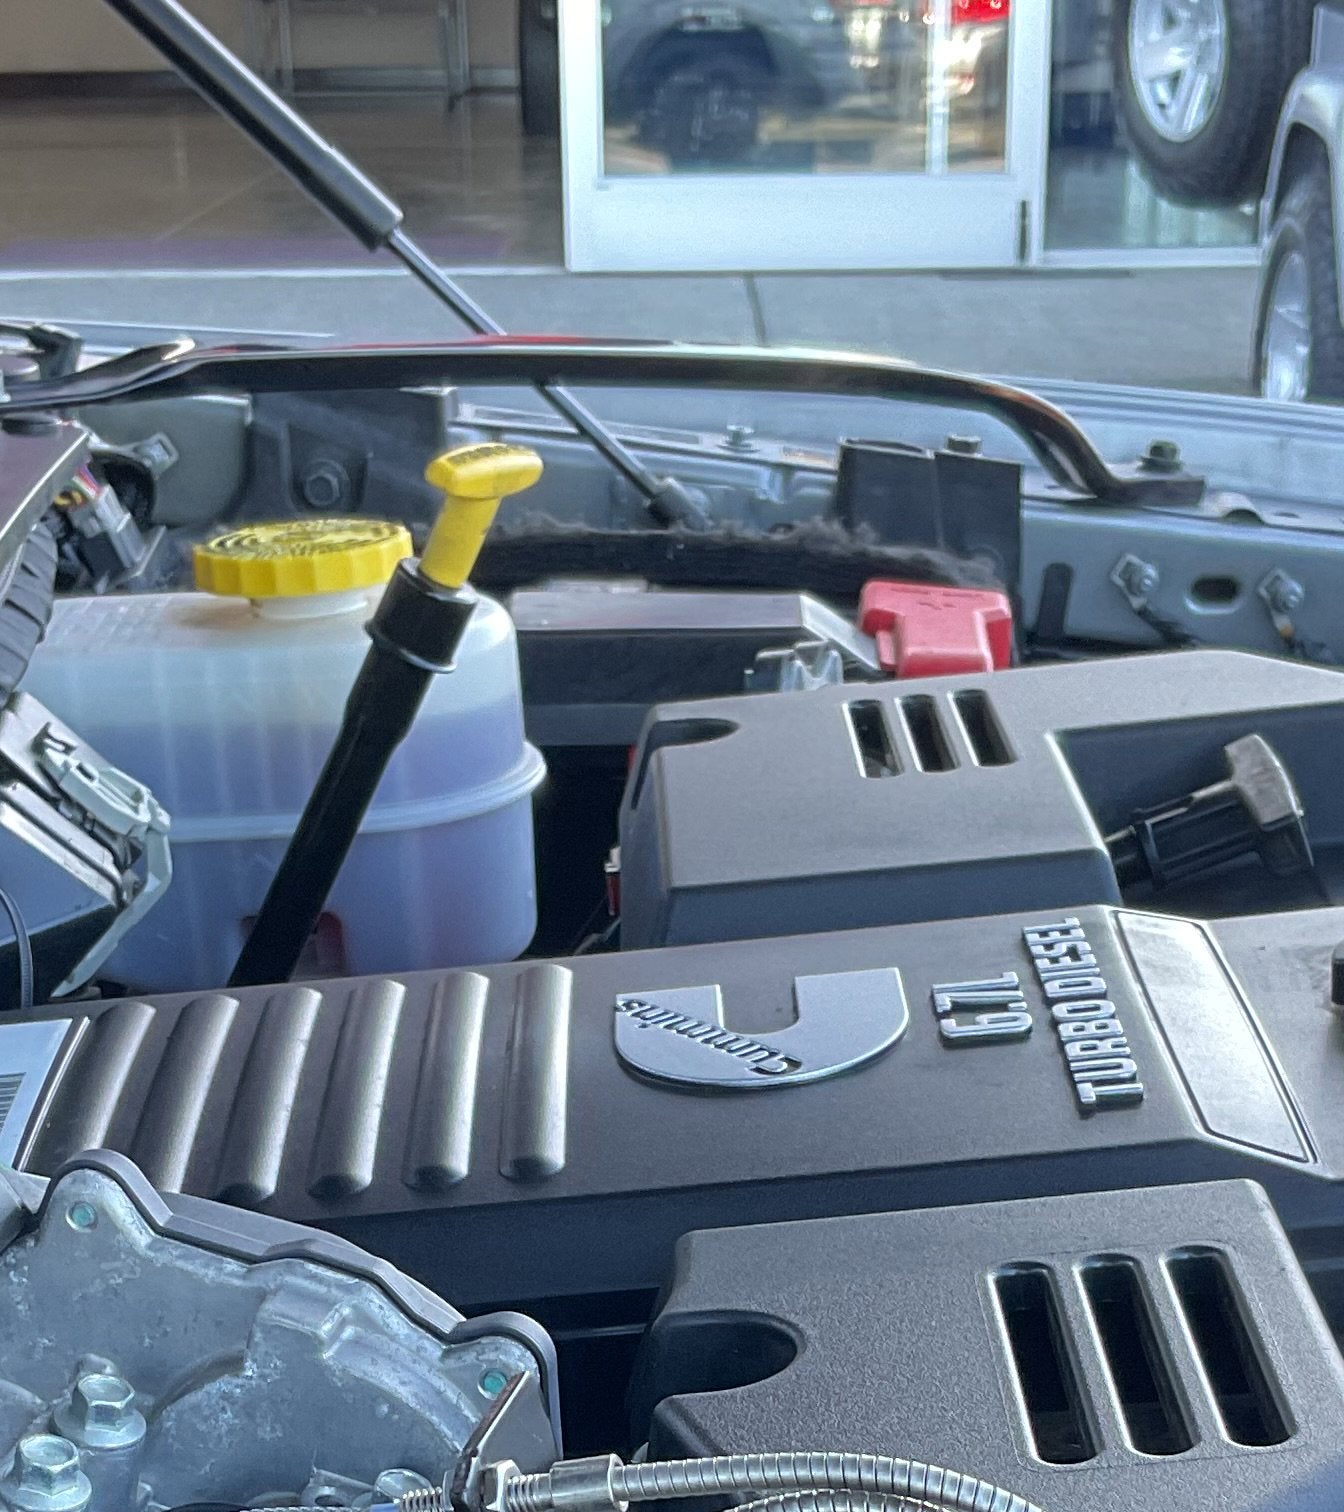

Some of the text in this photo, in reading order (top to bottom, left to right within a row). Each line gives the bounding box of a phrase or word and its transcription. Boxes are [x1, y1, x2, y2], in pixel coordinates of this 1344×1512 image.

[615, 998, 804, 1075] Cummins
[932, 970, 1033, 1044] 6.7L
[1022, 916, 1145, 1106] TURBO DIESEL
